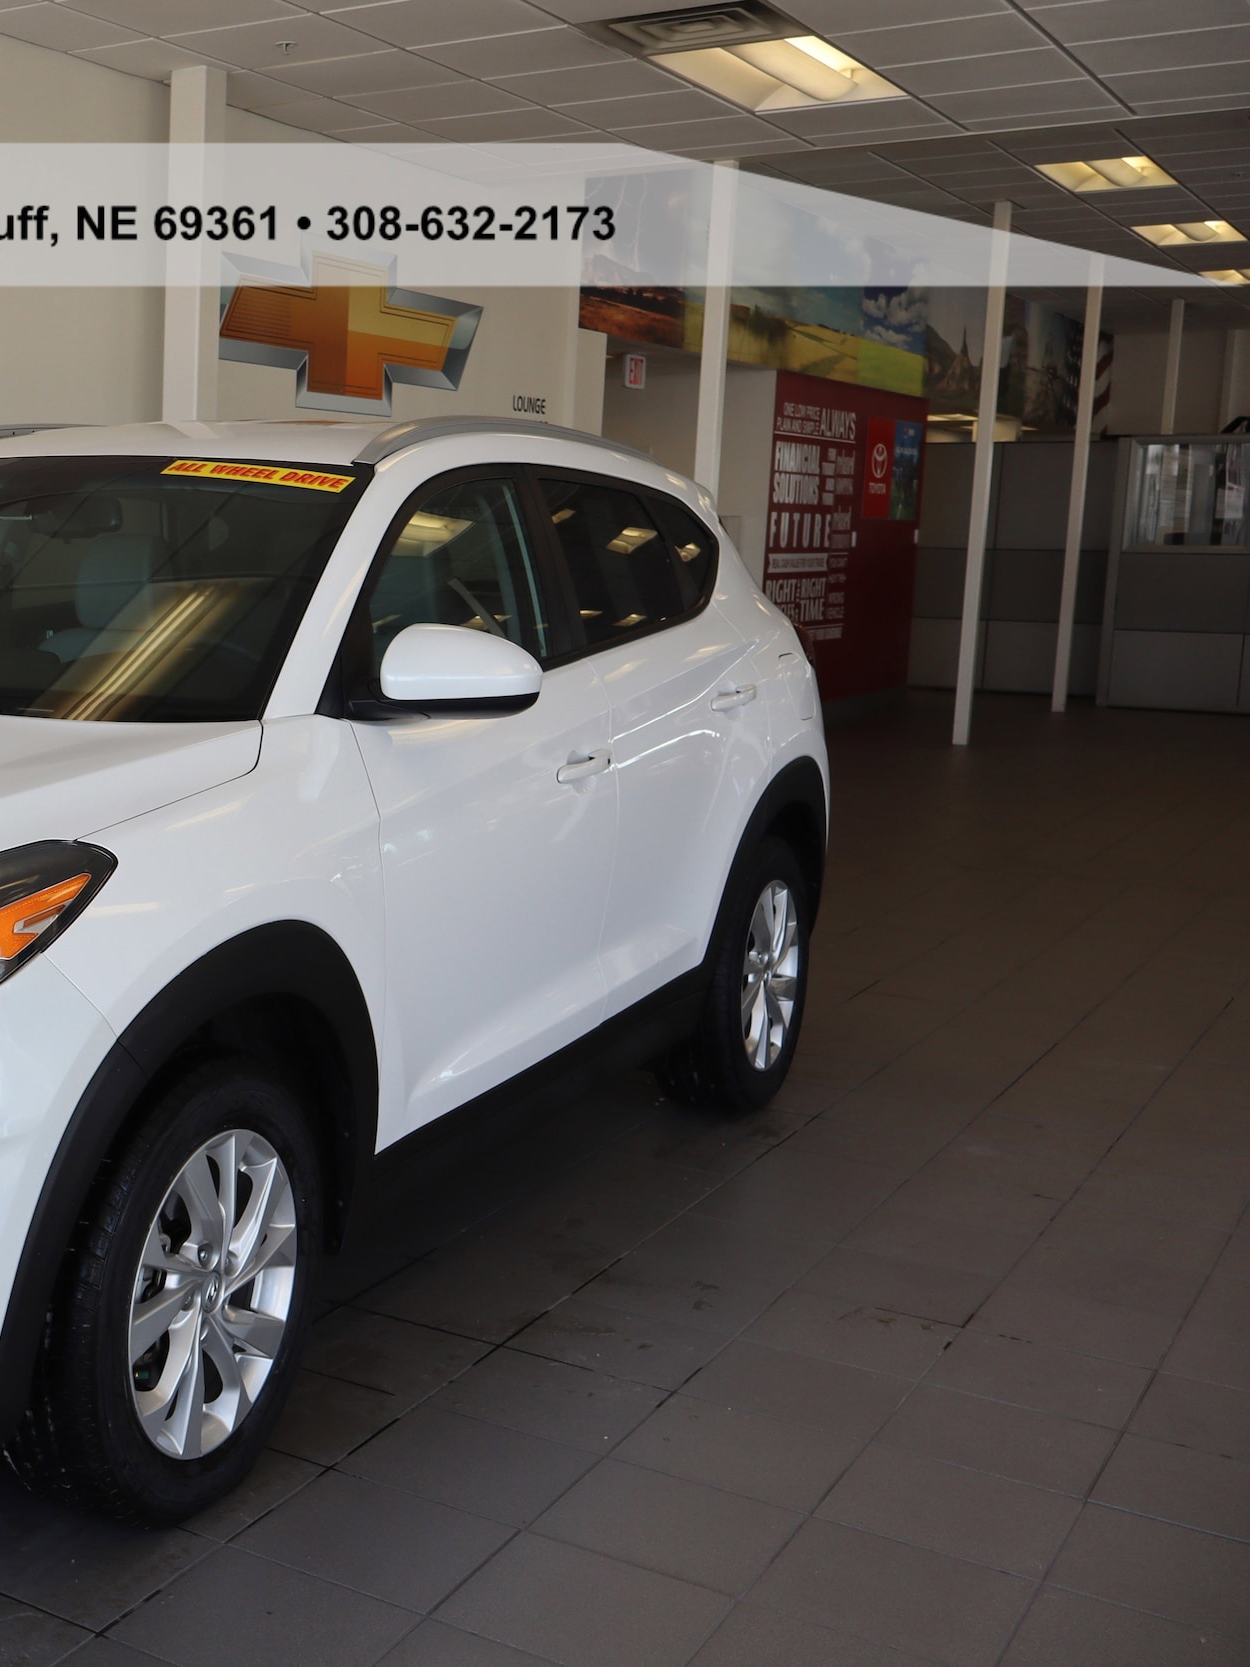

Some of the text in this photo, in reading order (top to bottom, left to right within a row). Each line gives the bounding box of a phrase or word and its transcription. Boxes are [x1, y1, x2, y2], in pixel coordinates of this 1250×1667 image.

[512, 394, 546, 415] LOUNGE
[819, 407, 857, 440] ALWAYS
[774, 440, 821, 475] FINANCIAL
[167, 462, 350, 489] ALL WHEEL DRIVE
[772, 472, 820, 505] SOLUTIONS
[769, 512, 831, 548] FUTURE
[765, 579, 797, 603] RIGHT
[801, 577, 827, 599] RIGHT
[800, 598, 825, 622] TIME
